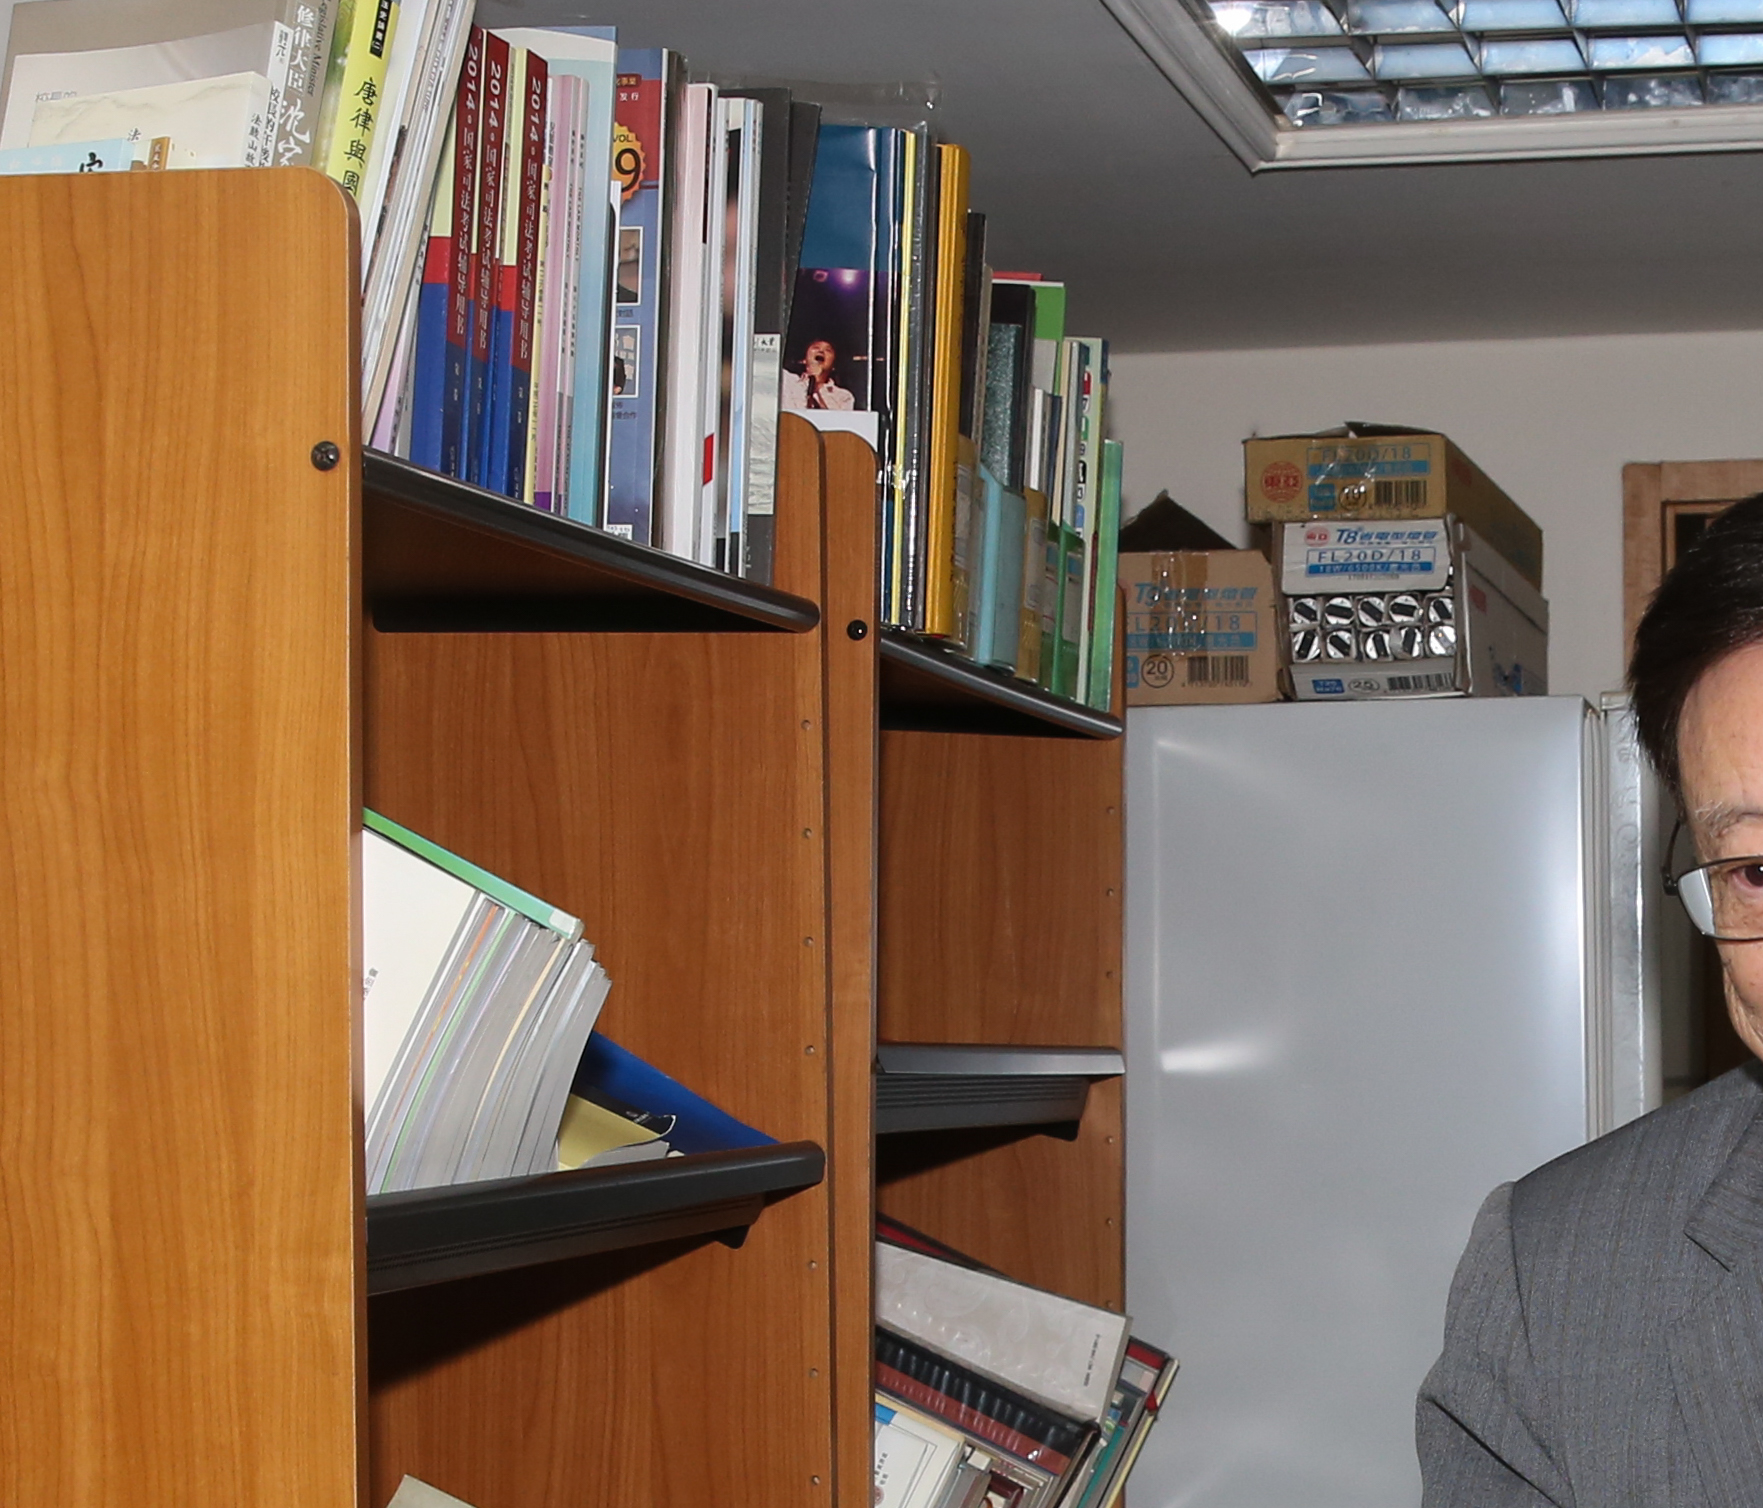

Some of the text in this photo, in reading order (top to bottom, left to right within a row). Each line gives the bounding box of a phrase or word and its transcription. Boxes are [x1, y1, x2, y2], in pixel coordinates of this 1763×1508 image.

[308, 0, 331, 97] egislative Minister
[466, 43, 478, 110] 2014
[489, 61, 501, 128] 2014
[530, 77, 541, 142] 2014
[615, 148, 641, 193] 9
[1318, 549, 1422, 563] FL20D/18
[1146, 661, 1168, 675] 20
